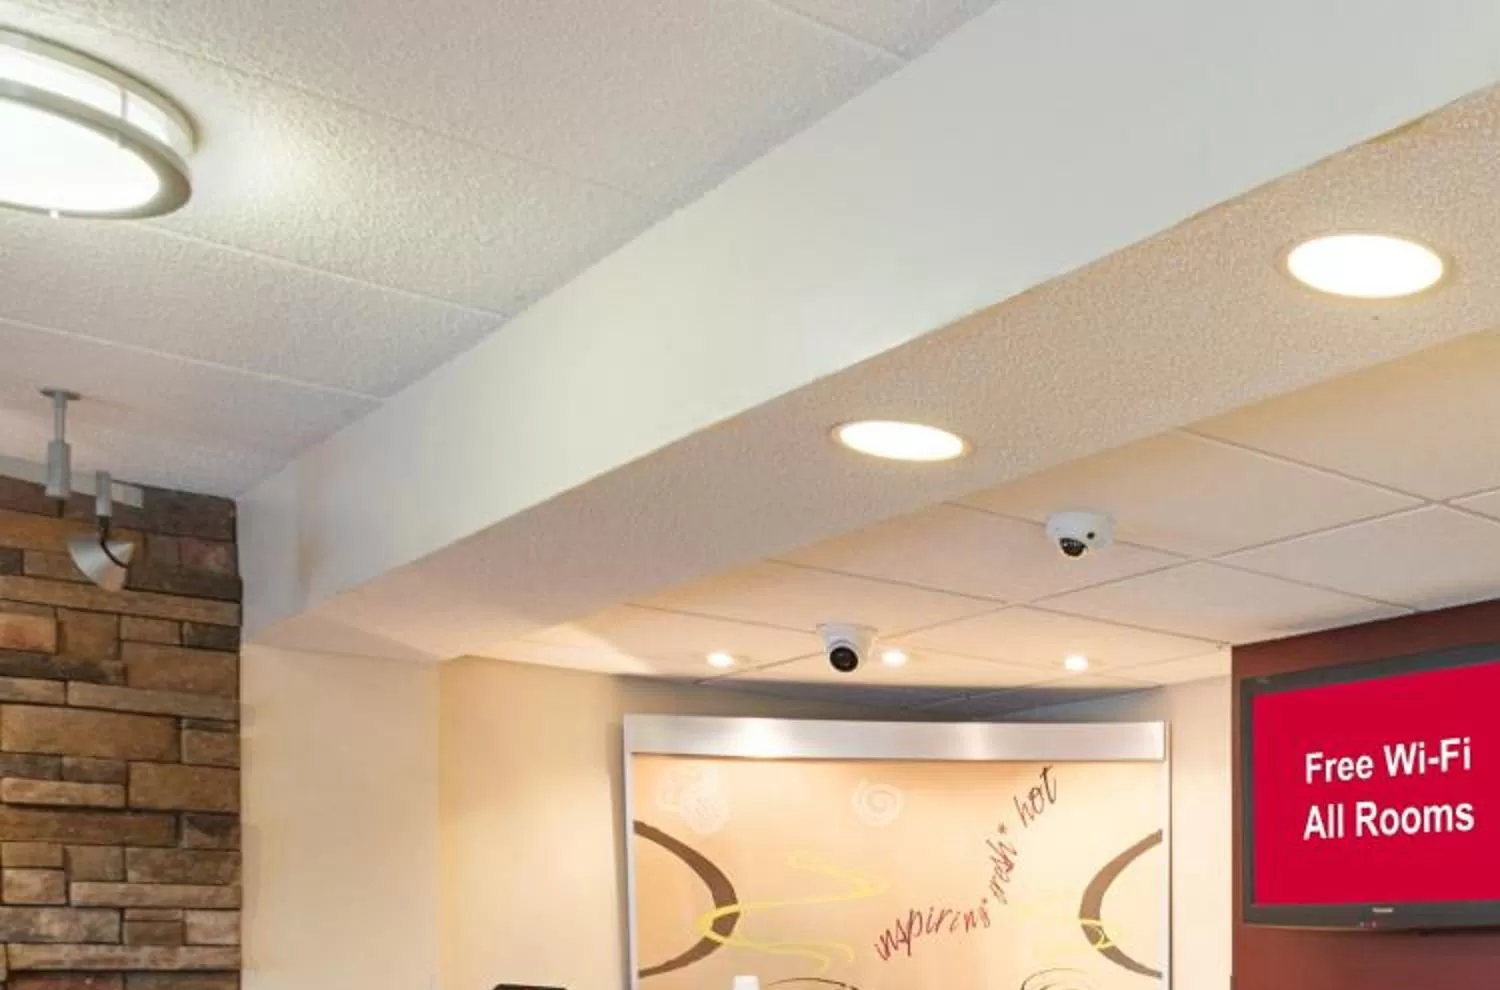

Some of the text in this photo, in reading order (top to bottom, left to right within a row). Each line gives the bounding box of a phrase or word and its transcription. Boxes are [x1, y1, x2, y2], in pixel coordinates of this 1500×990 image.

[1304, 737, 1471, 784] Free Wi-Fi
[1013, 764, 1057, 828] hot
[1303, 801, 1475, 841] All Rooms
